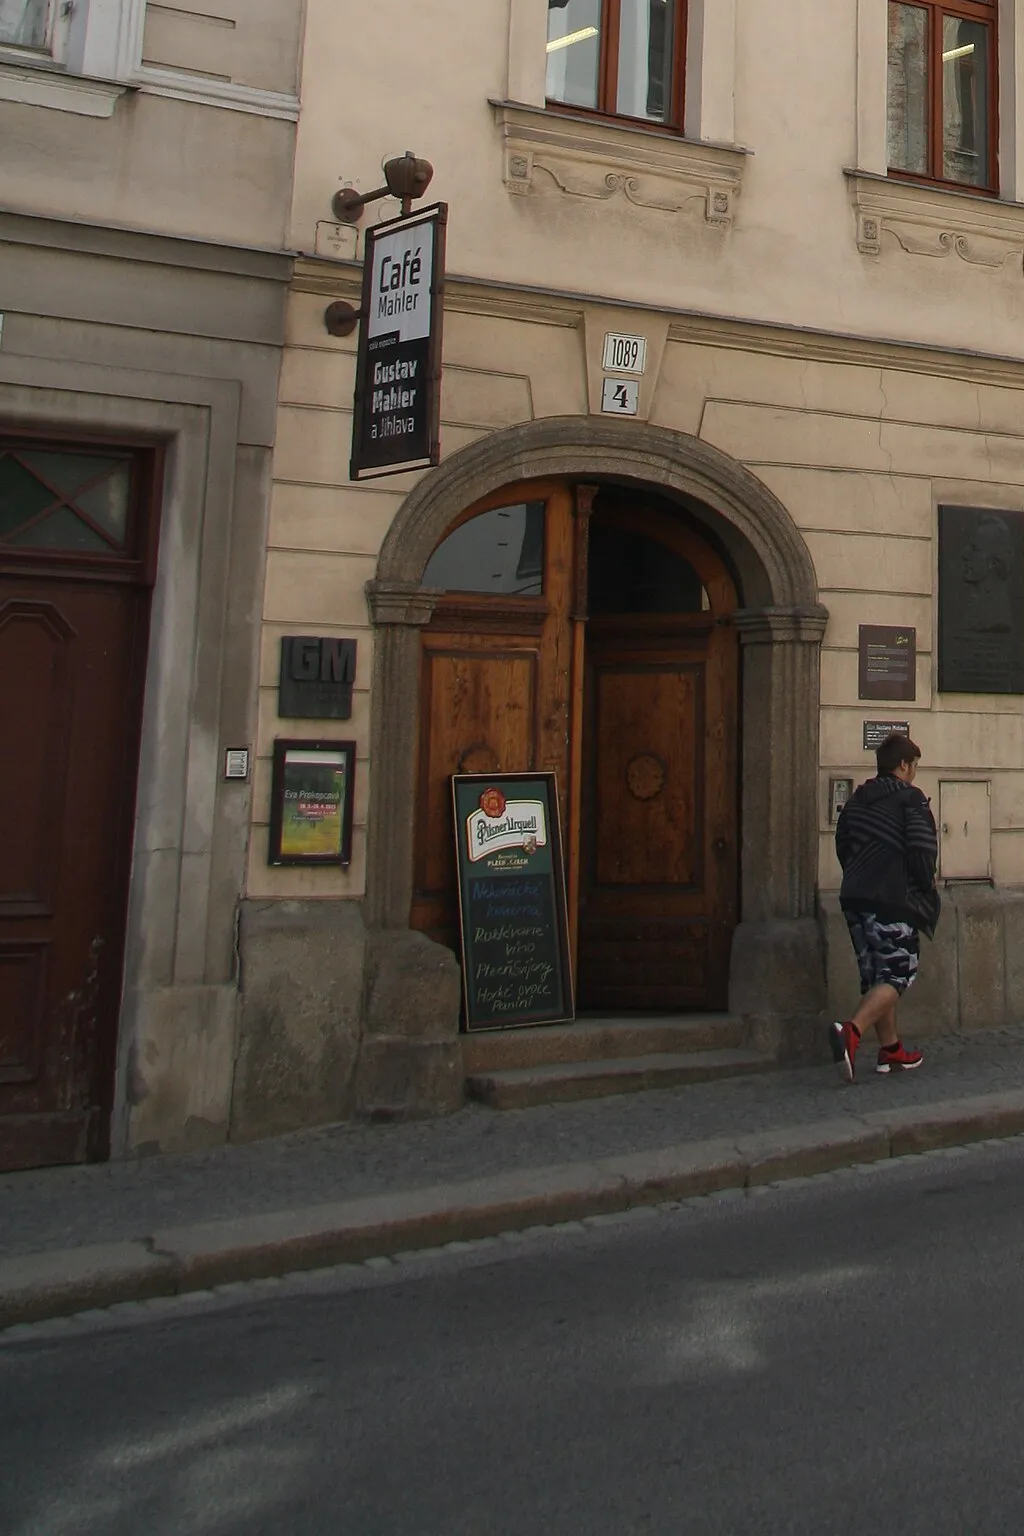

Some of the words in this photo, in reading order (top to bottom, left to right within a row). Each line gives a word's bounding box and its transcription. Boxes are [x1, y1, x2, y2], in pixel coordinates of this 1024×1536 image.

[380, 247, 422, 293] Café
[378, 291, 418, 319] Mahler
[611, 338, 639, 369] 1089
[374, 359, 417, 385] Gustav
[372, 386, 416, 413] Mahler
[612, 384, 629, 409] 4
[371, 424, 378, 438] a
[379, 415, 415, 438] Jihlava
[292, 636, 357, 682] GM
[285, 789, 298, 799] Eva
[477, 818, 508, 846] Pilsner
[506, 815, 537, 835] Urquell
